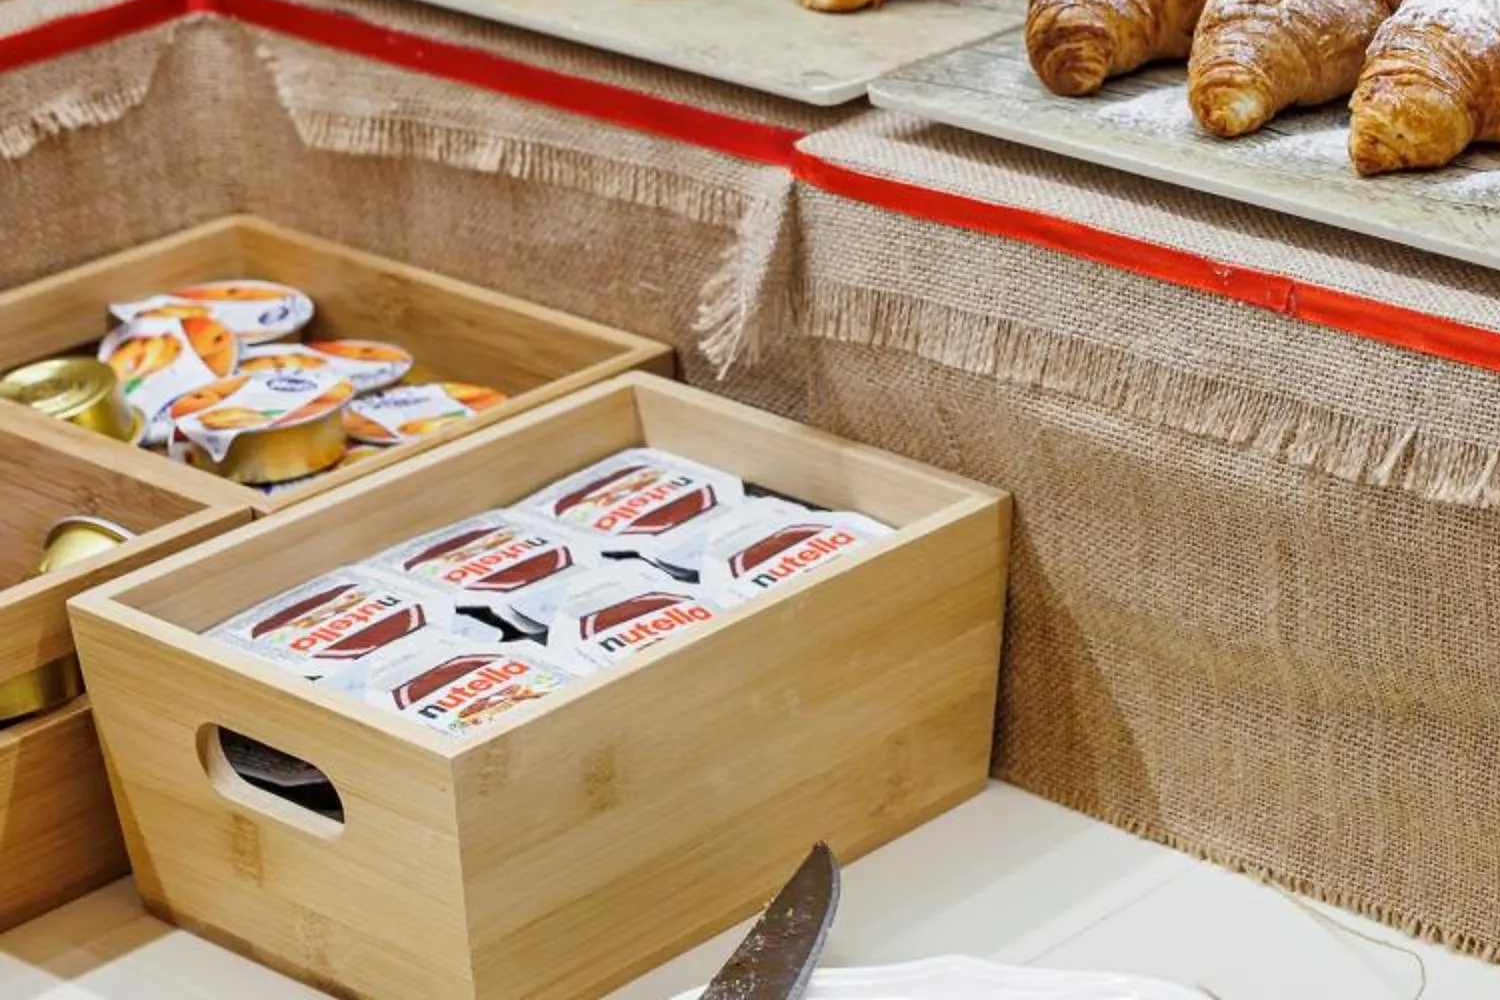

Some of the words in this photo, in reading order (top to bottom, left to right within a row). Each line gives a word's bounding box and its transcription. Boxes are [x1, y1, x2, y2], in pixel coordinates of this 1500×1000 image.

[591, 475, 693, 533] nutella
[442, 535, 549, 585] nutella
[751, 530, 857, 589] nutella
[289, 594, 402, 653] nutella
[598, 604, 713, 653] nutella
[418, 660, 530, 720] nutella
